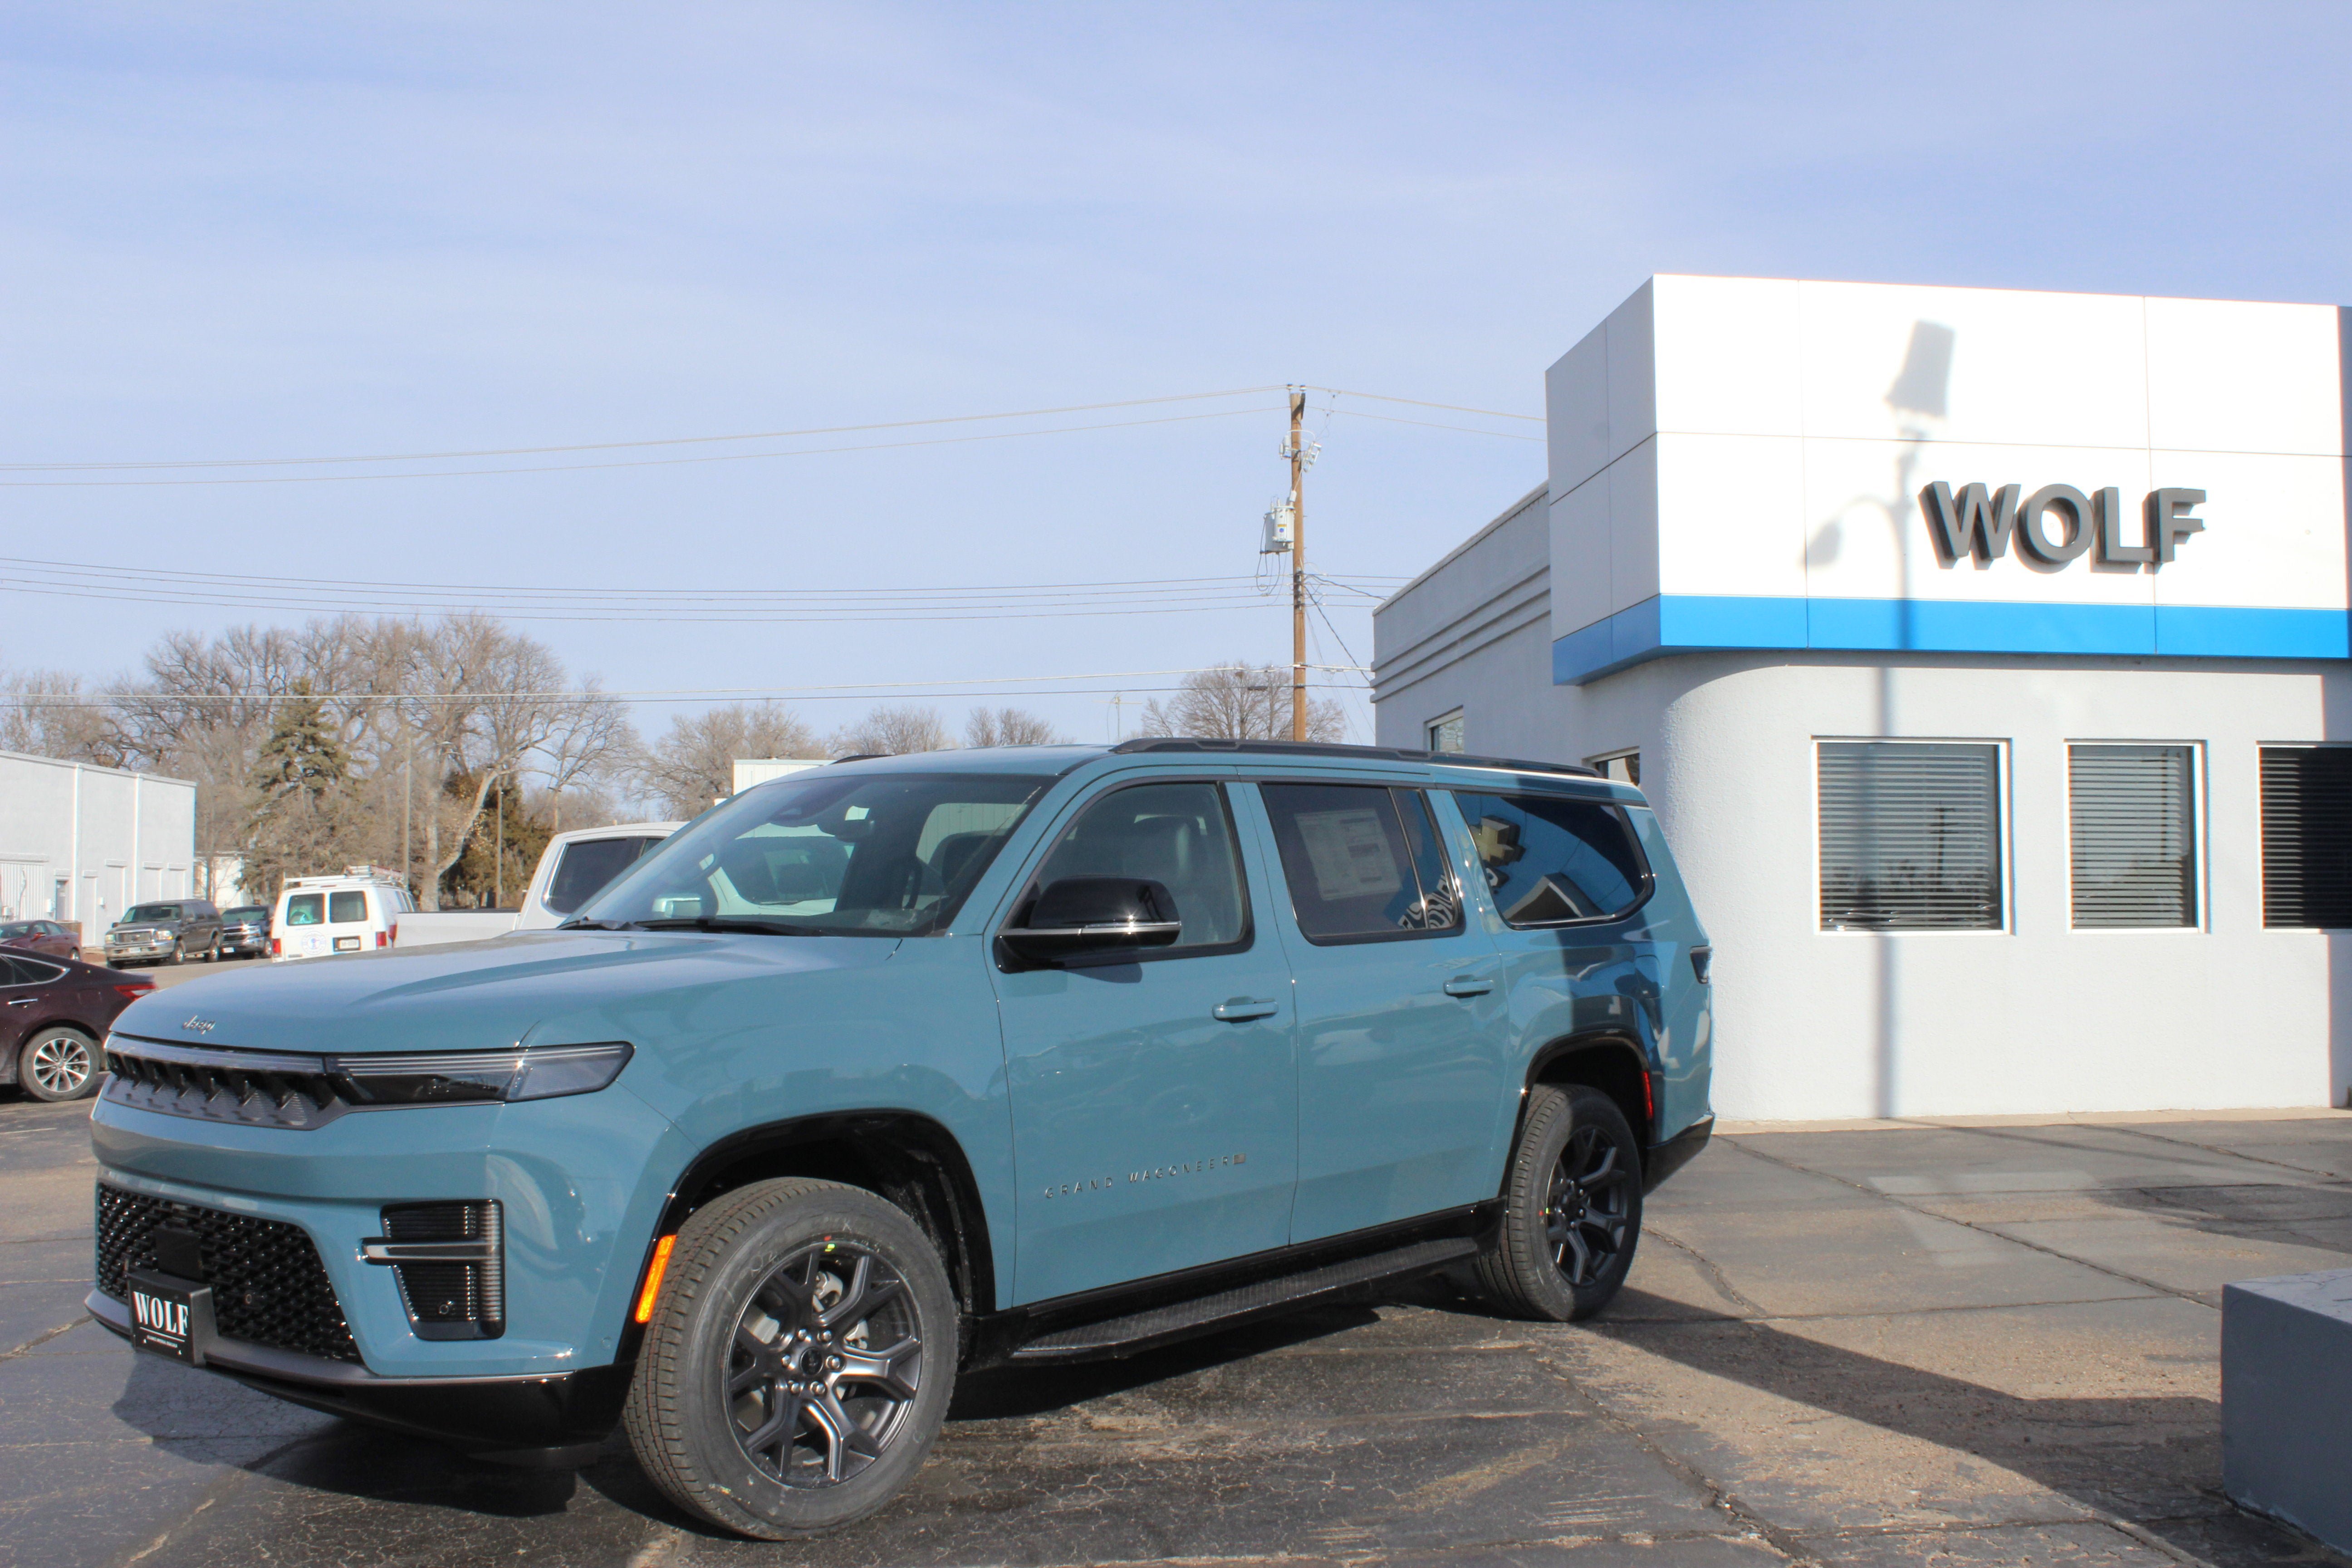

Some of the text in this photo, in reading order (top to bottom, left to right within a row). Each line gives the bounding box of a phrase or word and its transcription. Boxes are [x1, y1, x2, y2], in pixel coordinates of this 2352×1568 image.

[1922, 481, 2206, 565] WOLF
[182, 1014, 216, 1035] Jeep
[1045, 1156, 1229, 1198] GRAND WAGONEER
[133, 1291, 189, 1336] WOLF
